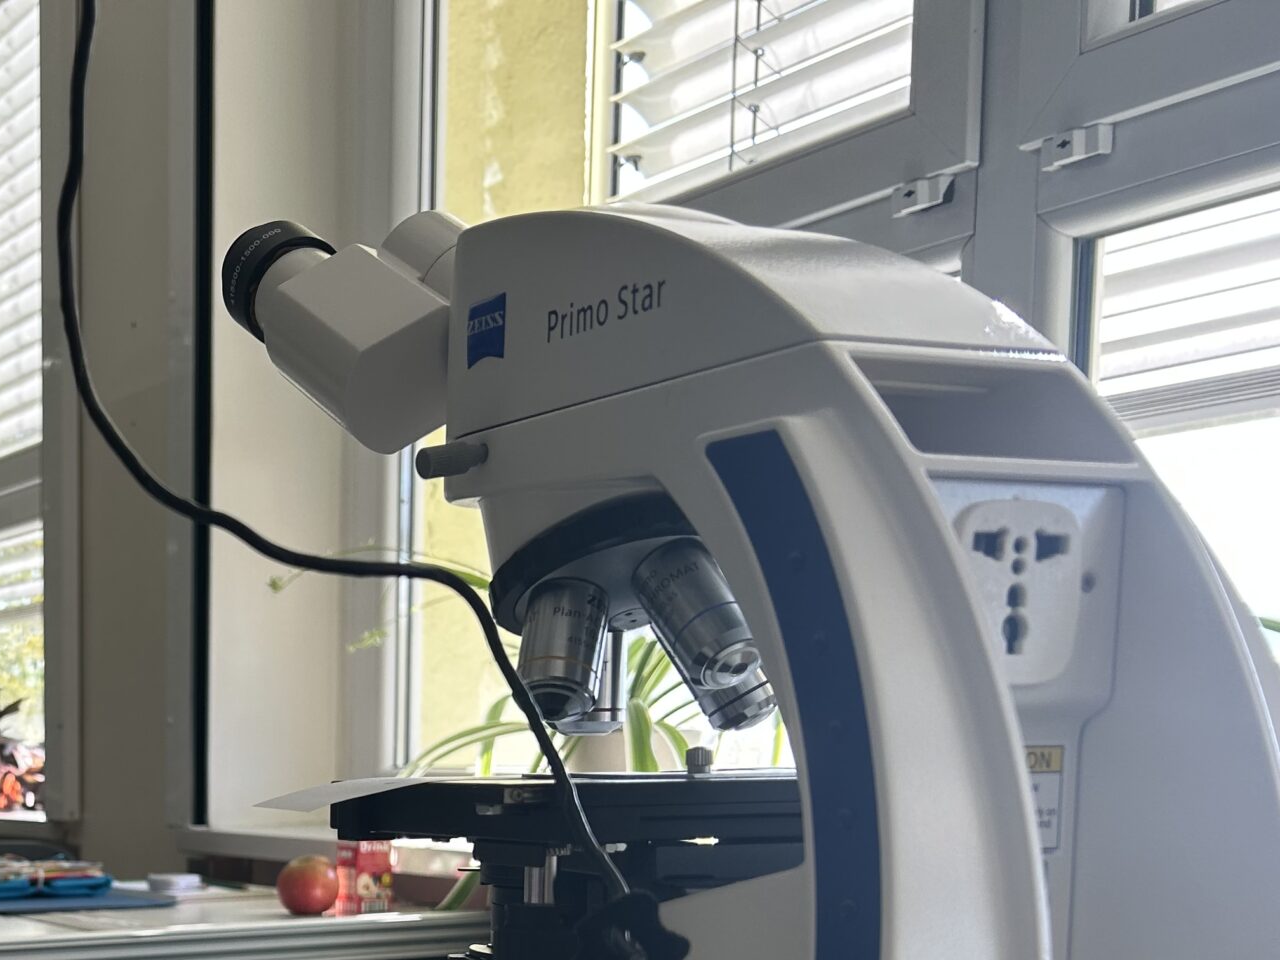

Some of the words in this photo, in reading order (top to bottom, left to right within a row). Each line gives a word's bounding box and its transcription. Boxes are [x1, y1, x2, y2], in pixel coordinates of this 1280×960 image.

[467, 311, 504, 336] ZEISS
[547, 299, 610, 343] Primo
[617, 280, 666, 320] Star
